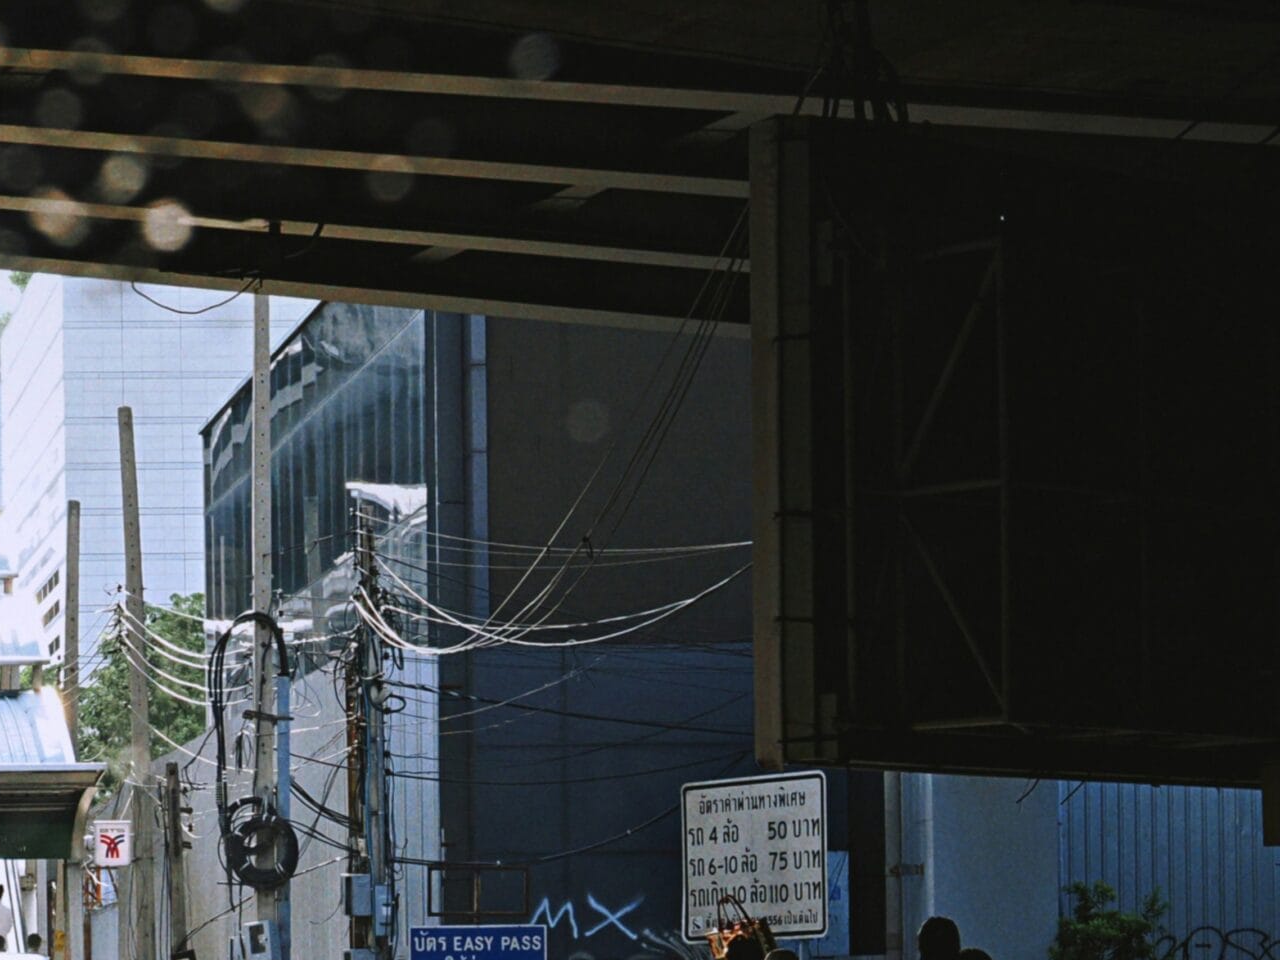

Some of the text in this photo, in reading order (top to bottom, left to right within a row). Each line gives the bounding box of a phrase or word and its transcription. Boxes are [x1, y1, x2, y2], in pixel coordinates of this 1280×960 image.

[699, 786, 806, 815] อัตราค่าผ่านทางพิเศษ
[688, 818, 821, 846] รถ 4 ล้อ 50 บาท
[689, 847, 821, 877] รถ 6-10 ล้อ 75 บาท
[750, 878, 767, 904] ล้อ
[770, 884, 789, 903] 110
[794, 881, 822, 902] บาท
[414, 930, 542, 952] บัตร EASY PASS
